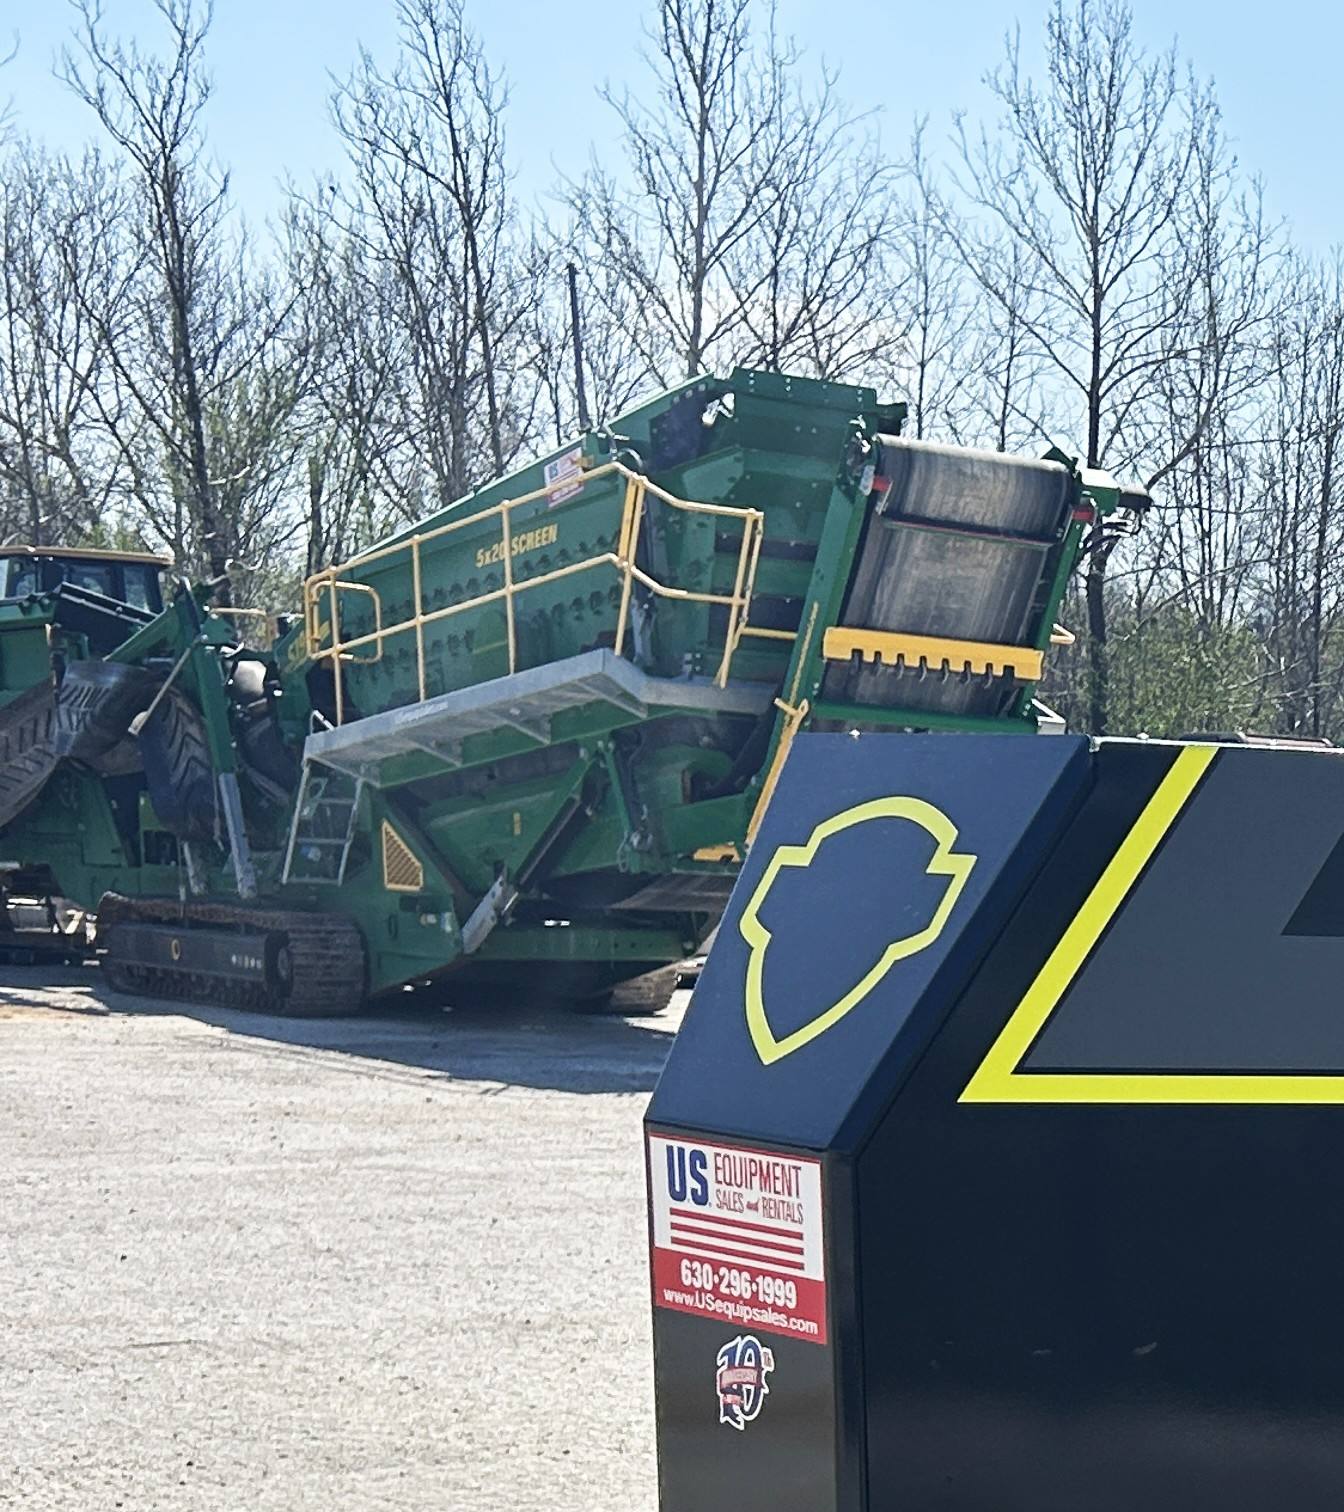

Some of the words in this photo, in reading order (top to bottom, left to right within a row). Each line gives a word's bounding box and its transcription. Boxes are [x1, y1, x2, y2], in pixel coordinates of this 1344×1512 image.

[511, 523, 558, 556] SCREEN
[713, 1152, 802, 1199] EQUIPMENT
[715, 1189, 744, 1213] SALES
[761, 1196, 804, 1225] RENTALS
[663, 1288, 818, 1335] www.USequipsales.com
